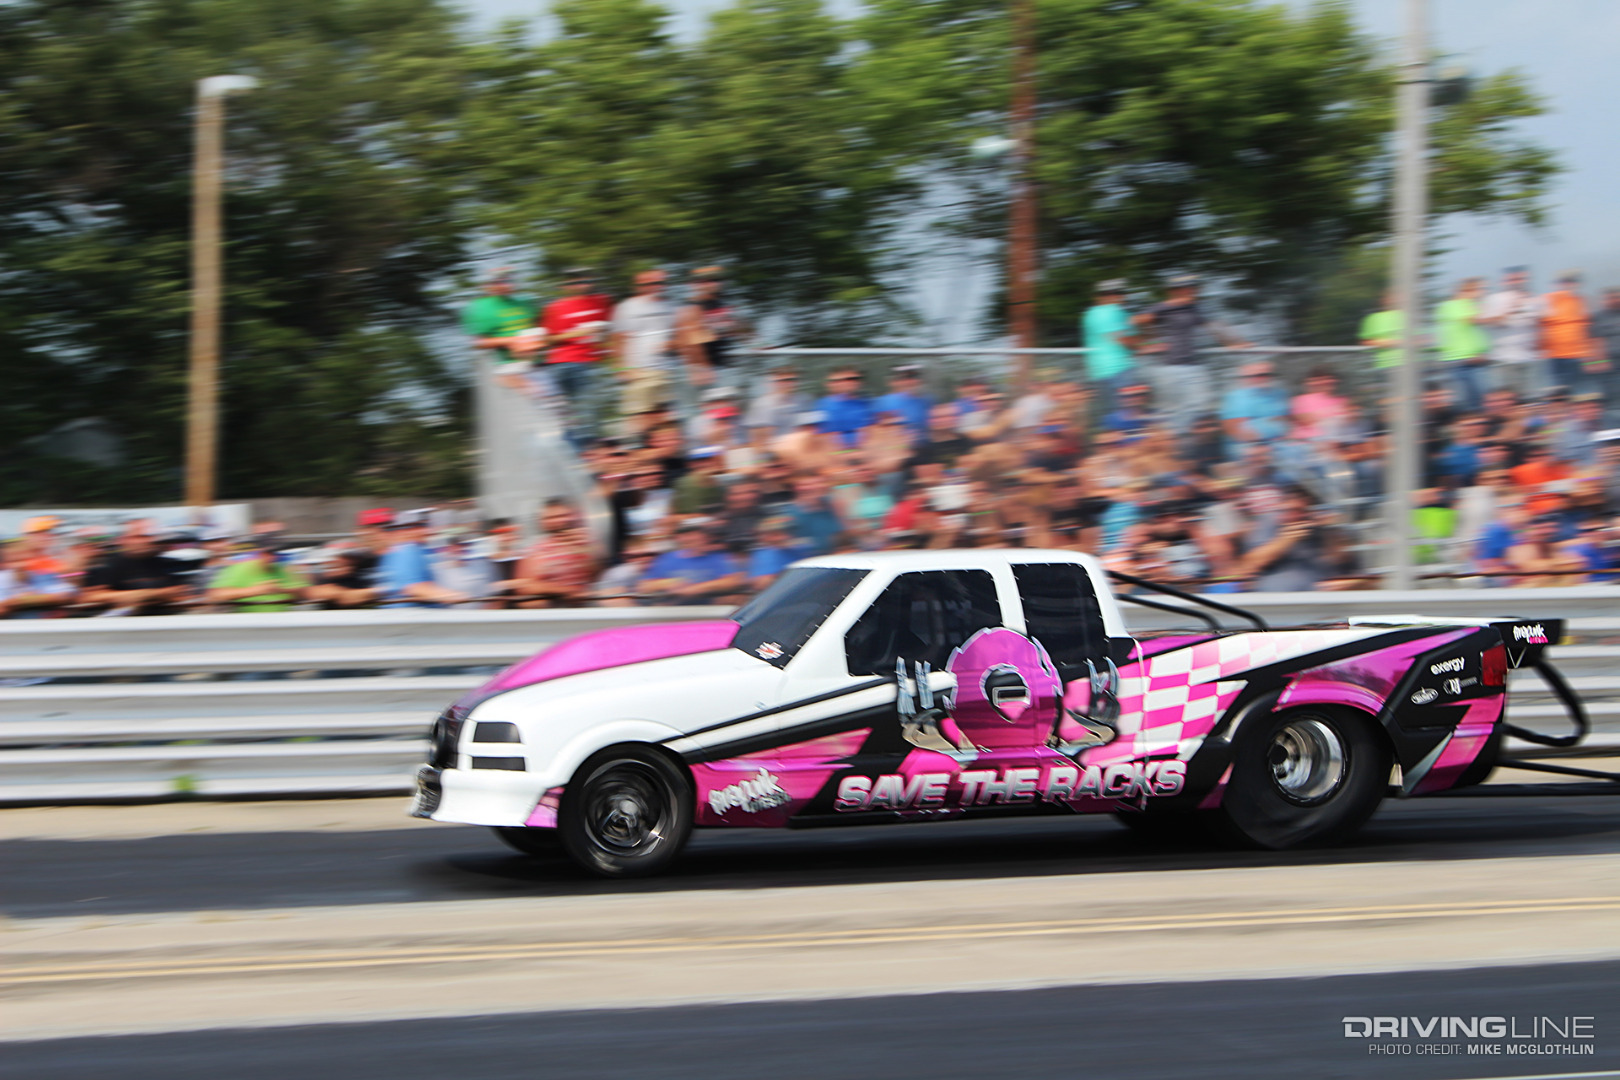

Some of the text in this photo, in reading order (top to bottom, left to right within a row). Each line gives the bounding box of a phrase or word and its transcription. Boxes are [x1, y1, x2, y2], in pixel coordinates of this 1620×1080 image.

[1430, 656, 1465, 676] exergy
[834, 773, 951, 811] SAVE
[958, 767, 1040, 805] THE
[1042, 760, 1188, 803] RACKS
